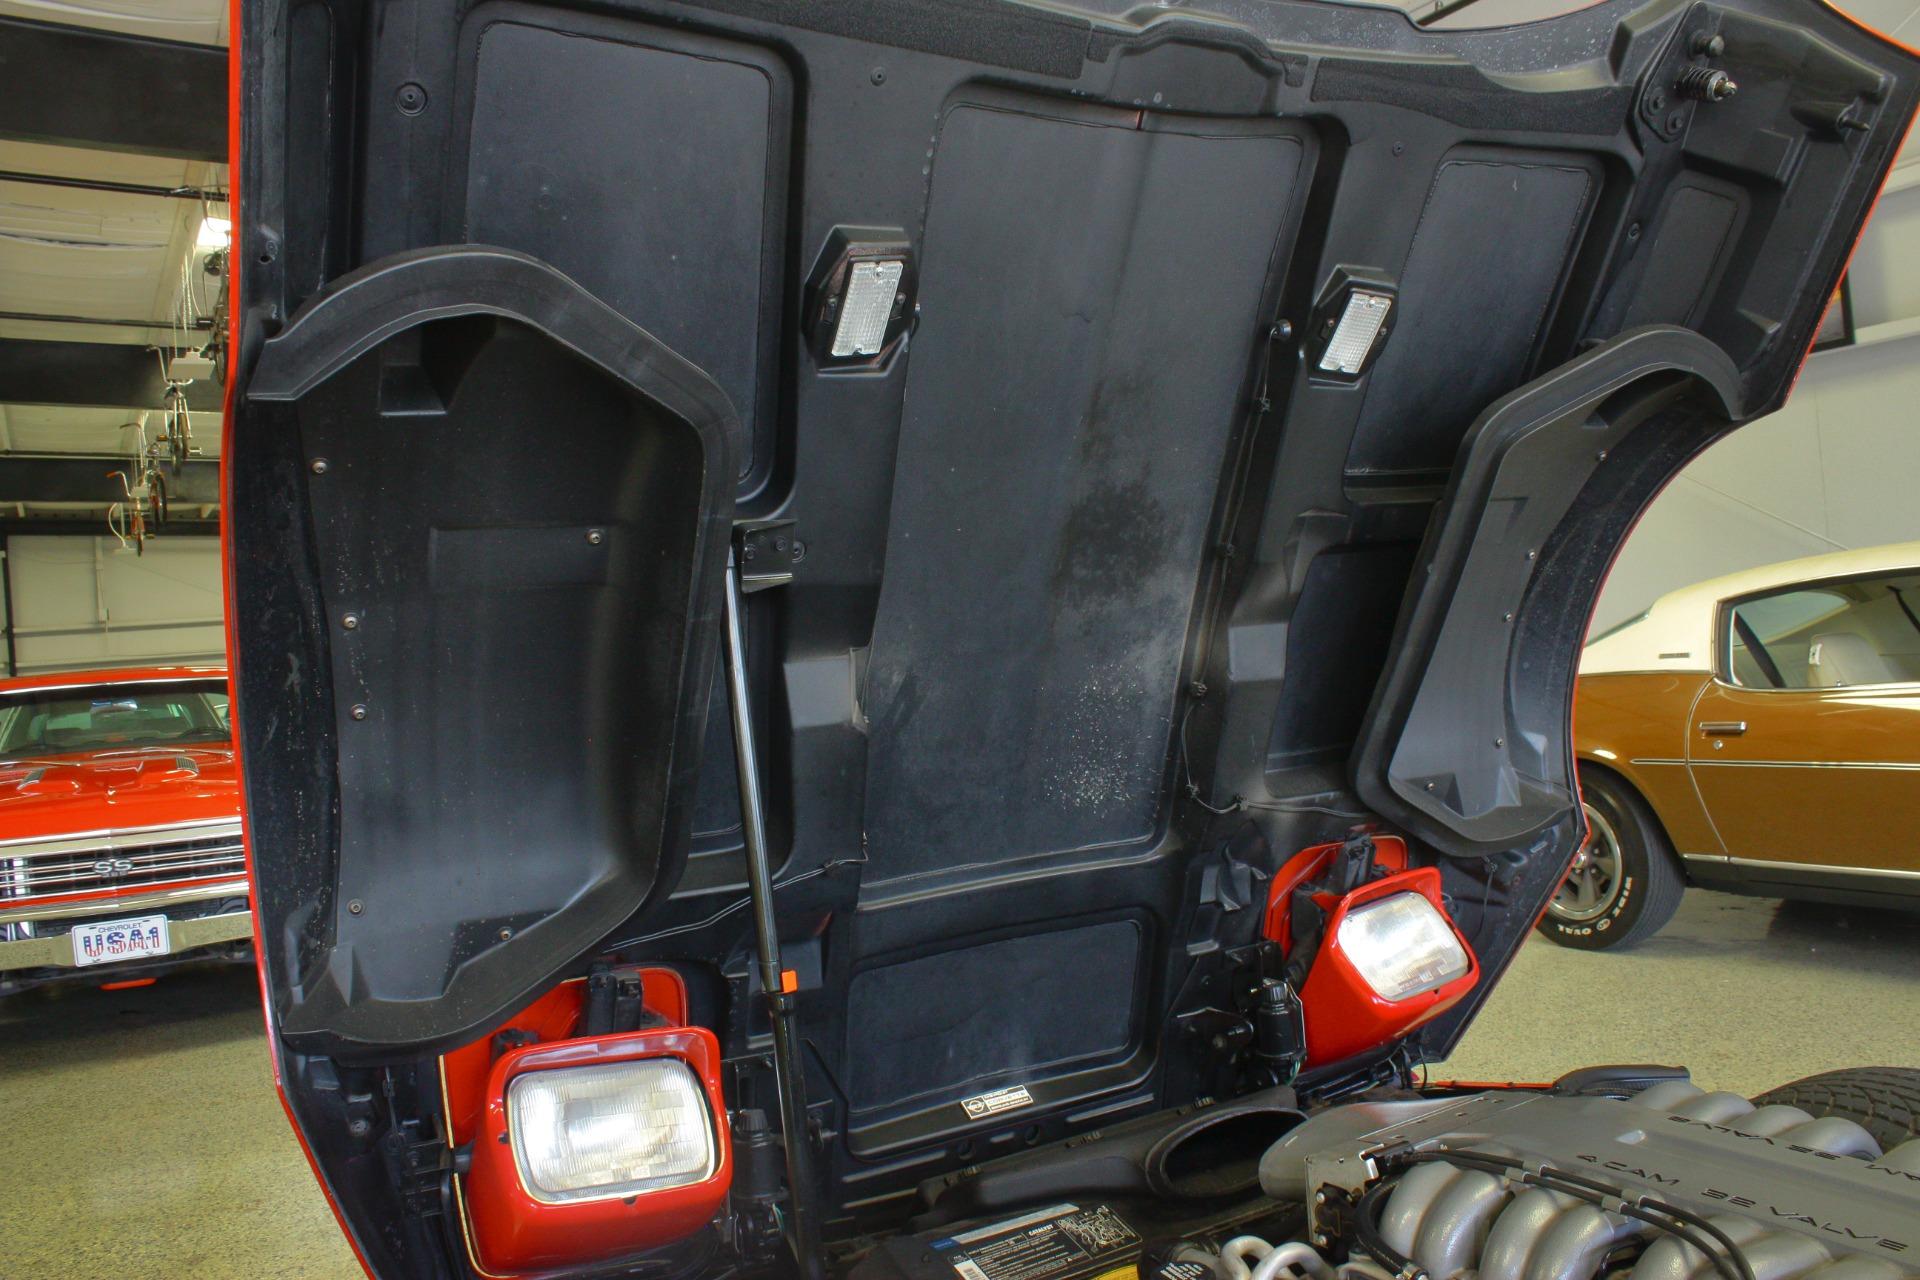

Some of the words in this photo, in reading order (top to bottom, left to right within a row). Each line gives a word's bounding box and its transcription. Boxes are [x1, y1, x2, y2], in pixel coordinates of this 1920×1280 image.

[94, 859, 132, 874] SS
[1612, 876, 1633, 918] WIDE
[98, 922, 142, 934] CHEVROLET
[1557, 923, 1592, 935] OVAL
[1667, 1115, 1775, 1146] VALVE
[1577, 1154, 1598, 1163] 4
[1602, 1160, 1681, 1186] CAM
[1700, 1187, 1756, 1208] 32
[1770, 1206, 1909, 1252] VALVE
[1028, 1224, 1054, 1236] CATALYST
